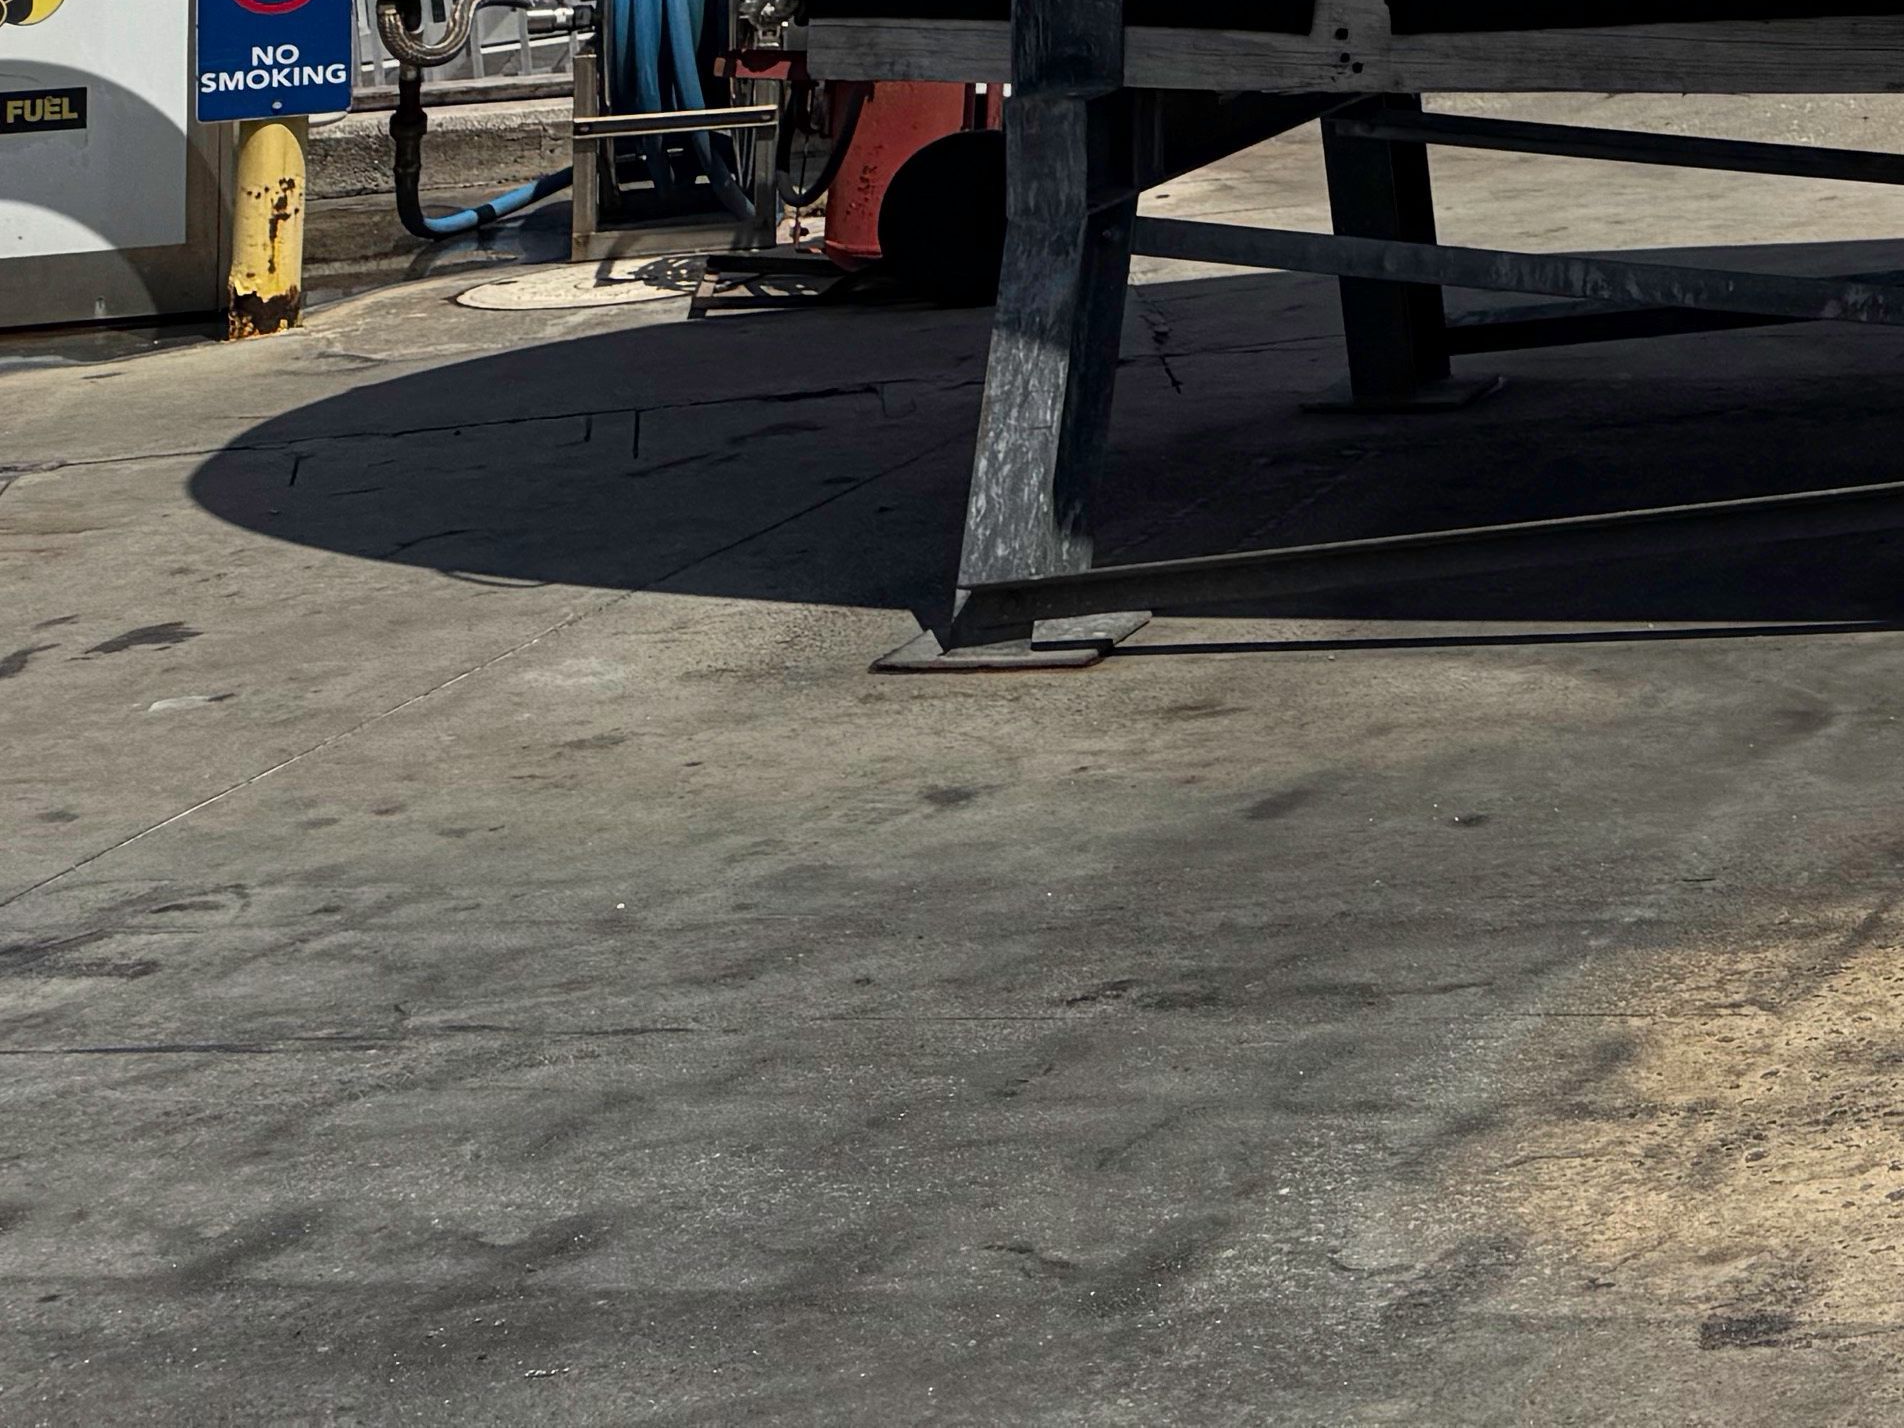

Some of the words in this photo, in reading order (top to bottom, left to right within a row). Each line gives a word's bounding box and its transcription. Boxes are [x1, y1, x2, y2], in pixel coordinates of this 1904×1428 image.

[252, 44, 299, 66] NO
[201, 63, 347, 93] SMOKING
[6, 96, 79, 123] FUEL
